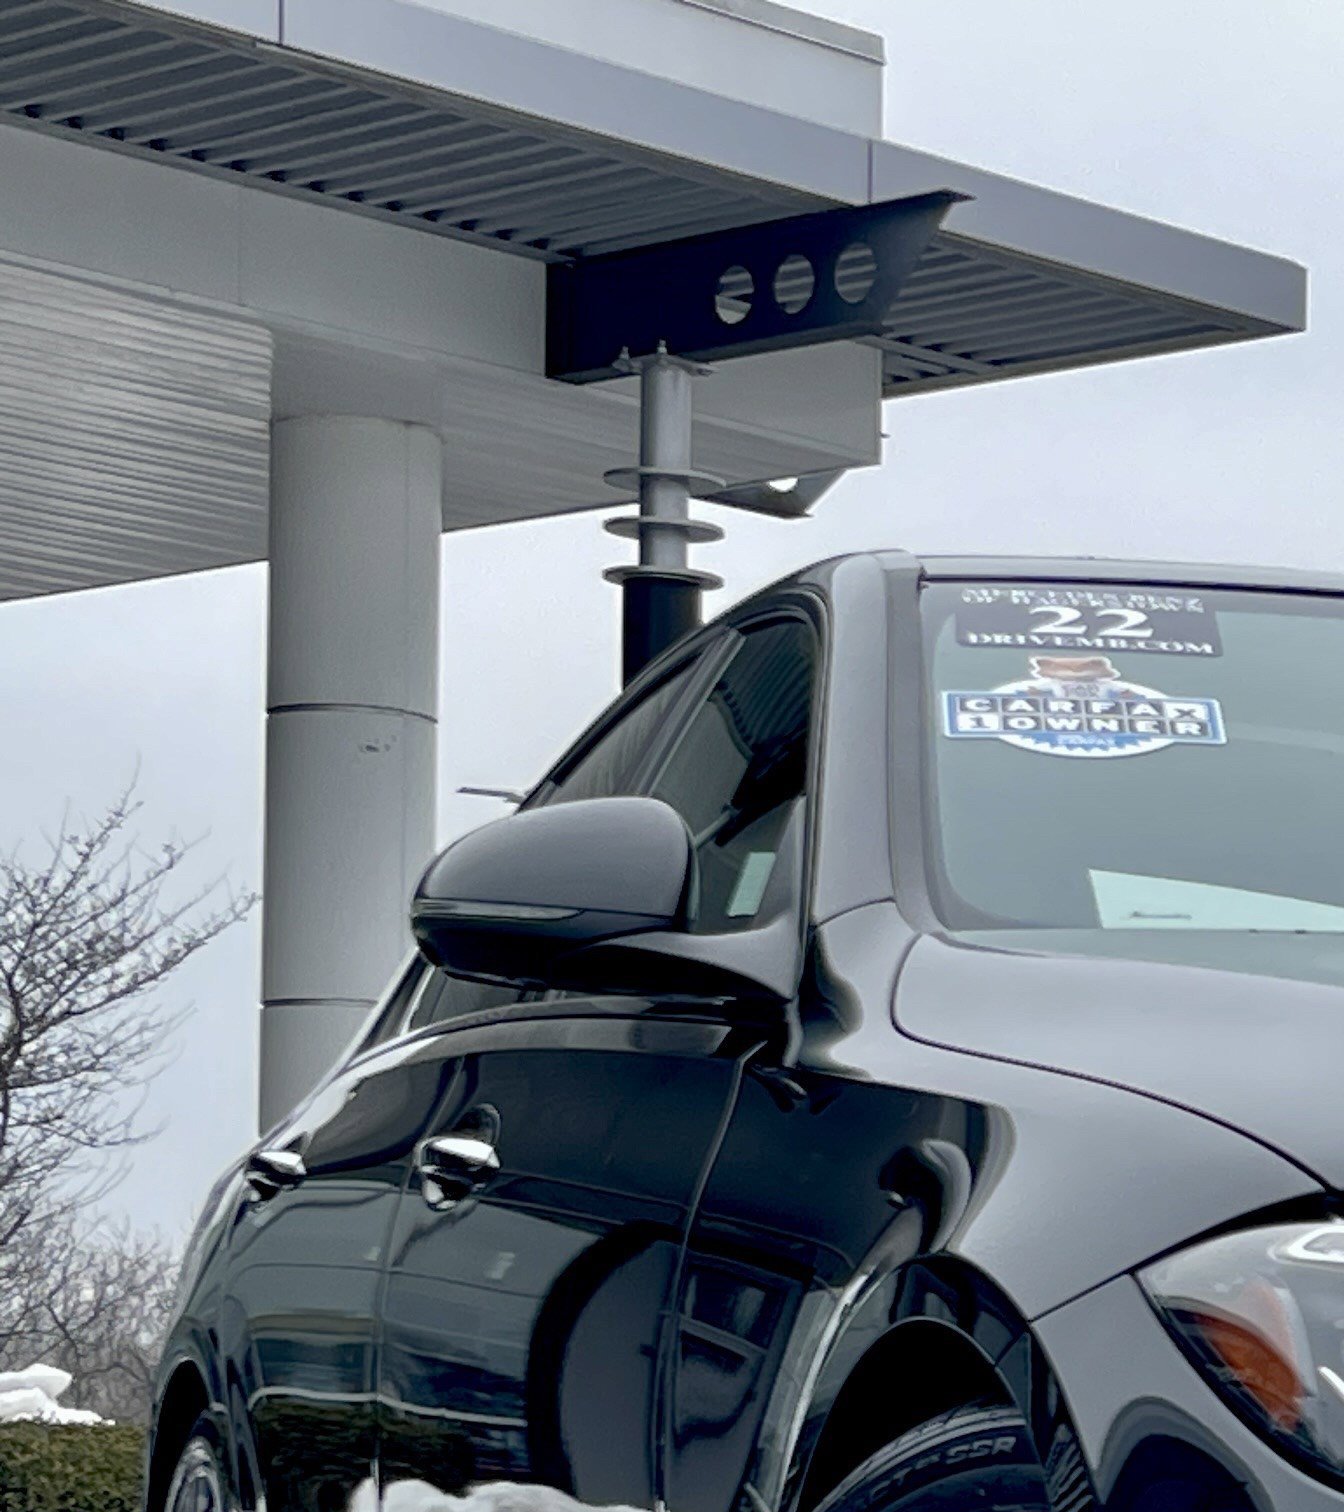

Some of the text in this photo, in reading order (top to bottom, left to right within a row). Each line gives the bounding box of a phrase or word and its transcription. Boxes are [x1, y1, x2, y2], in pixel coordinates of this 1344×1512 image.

[1029, 606, 1154, 638] 22
[969, 632, 1214, 654] DRIVEMB.COM
[965, 699, 1198, 719] CARFAX
